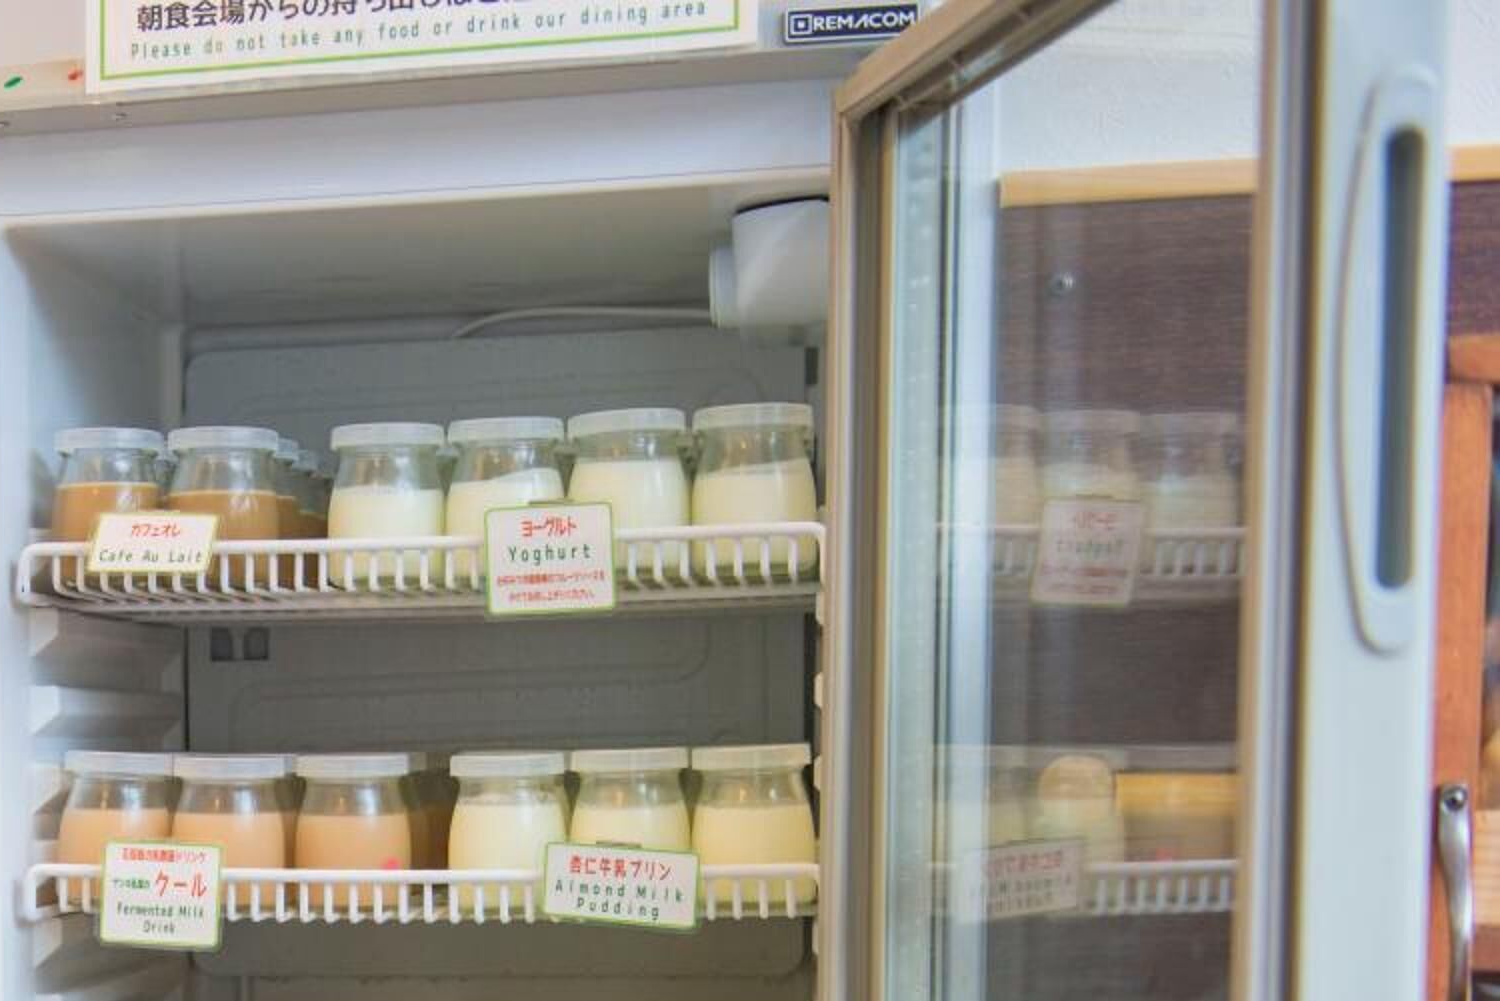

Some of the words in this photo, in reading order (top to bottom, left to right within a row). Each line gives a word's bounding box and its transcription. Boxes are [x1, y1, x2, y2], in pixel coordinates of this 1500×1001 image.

[131, 42, 191, 60] Please
[204, 37, 223, 55] do
[236, 34, 265, 51] not
[280, 31, 320, 48] take
[334, 29, 364, 47] any
[379, 22, 419, 40] food
[433, 21, 452, 36] or
[467, 14, 520, 33] drink
[535, 12, 565, 28] our
[581, 5, 648, 25] dining
[661, 1, 706, 19] area
[813, 10, 915, 31] REMACOM
[520, 515, 577, 537] ヨーグルト
[100, 549, 132, 562] Cafe
[142, 549, 159, 562] Au
[169, 549, 202, 563] Lait
[508, 543, 592, 567] Yoghurt
[569, 856, 672, 881] 杏仁牛乳プリン
[155, 869, 207, 897] クール
[555, 879, 626, 897] Almond
[636, 886, 683, 902] Milk
[117, 901, 173, 917] Fermented
[179, 905, 204, 918] Milk
[576, 897, 660, 921] Pudding
[142, 920, 175, 934] Drink
